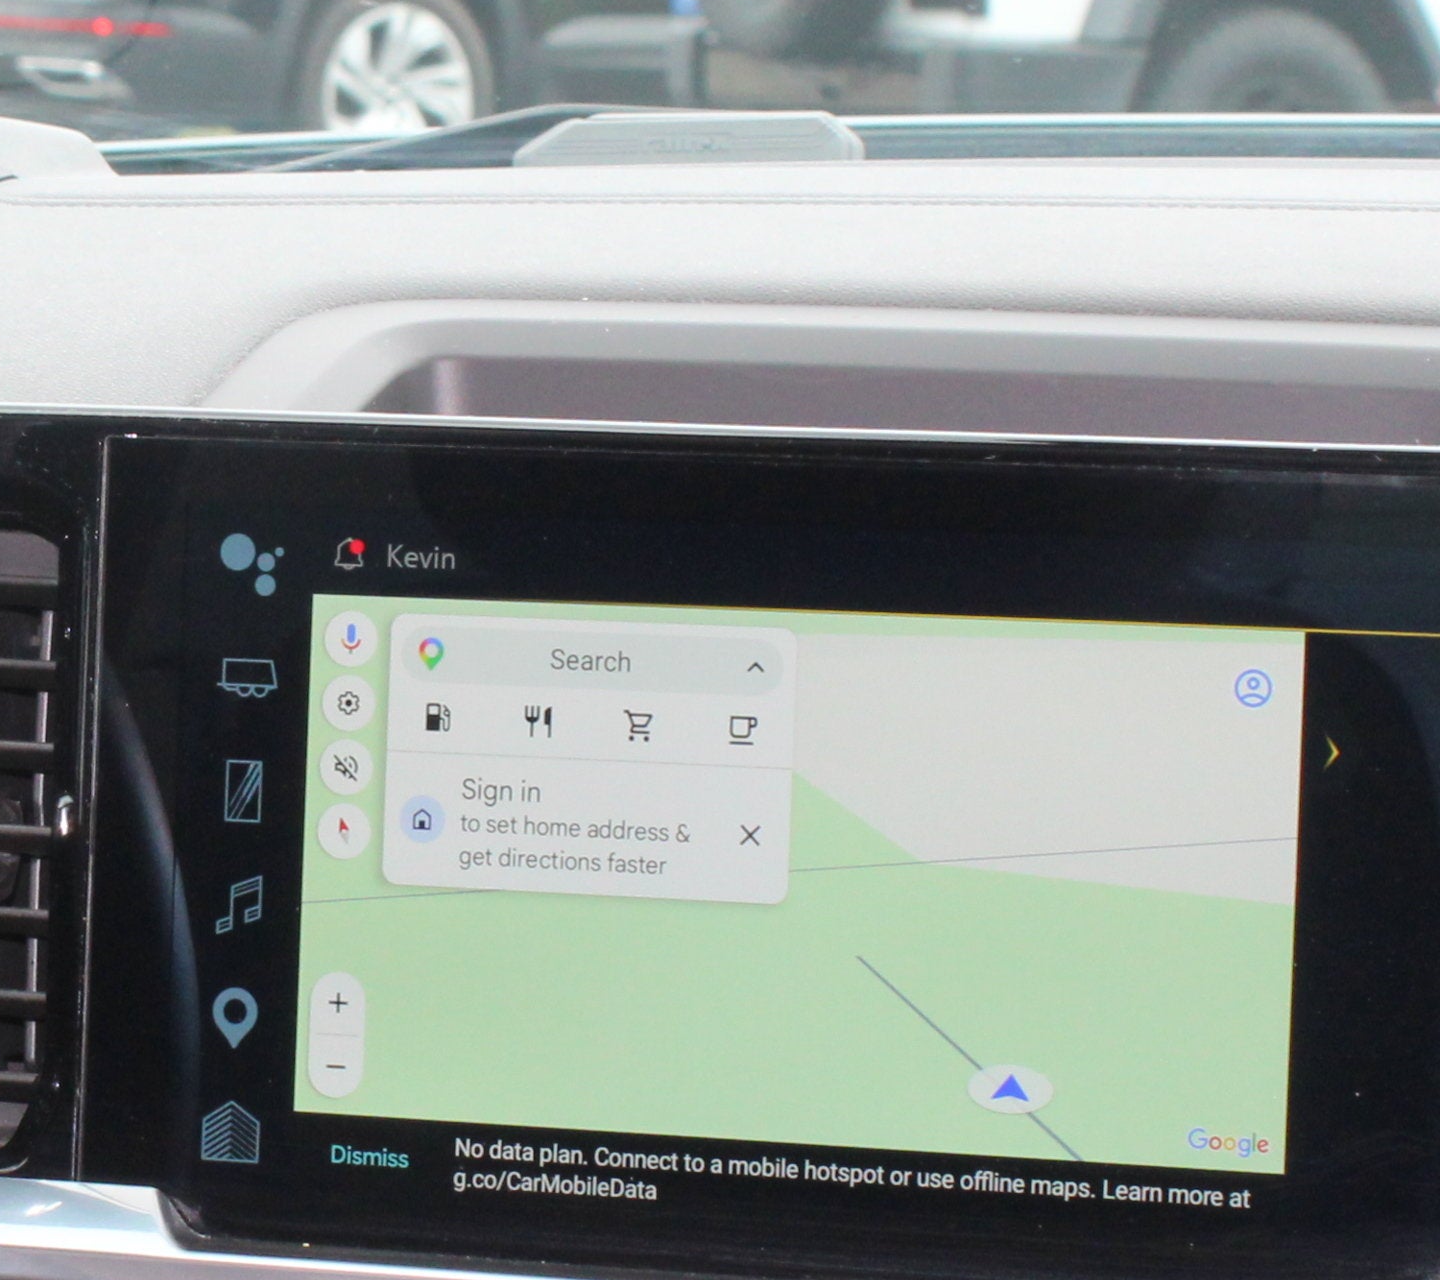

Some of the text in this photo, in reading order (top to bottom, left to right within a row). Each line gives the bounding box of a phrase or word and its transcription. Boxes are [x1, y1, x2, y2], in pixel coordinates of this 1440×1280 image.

[385, 543, 456, 570] Kevin
[550, 648, 631, 673] Search
[462, 777, 541, 806] Sign in
[460, 815, 690, 844] to set home address &
[459, 847, 667, 875] get directions faster
[330, 1144, 409, 1168] Dismiss
[1188, 1128, 1269, 1158] Google
[453, 1170, 657, 1200] g.co/CarMobileData
[455, 1138, 1251, 1208] No data plan. Connect to a mobile hotspot or use offline maps. Learn more at
